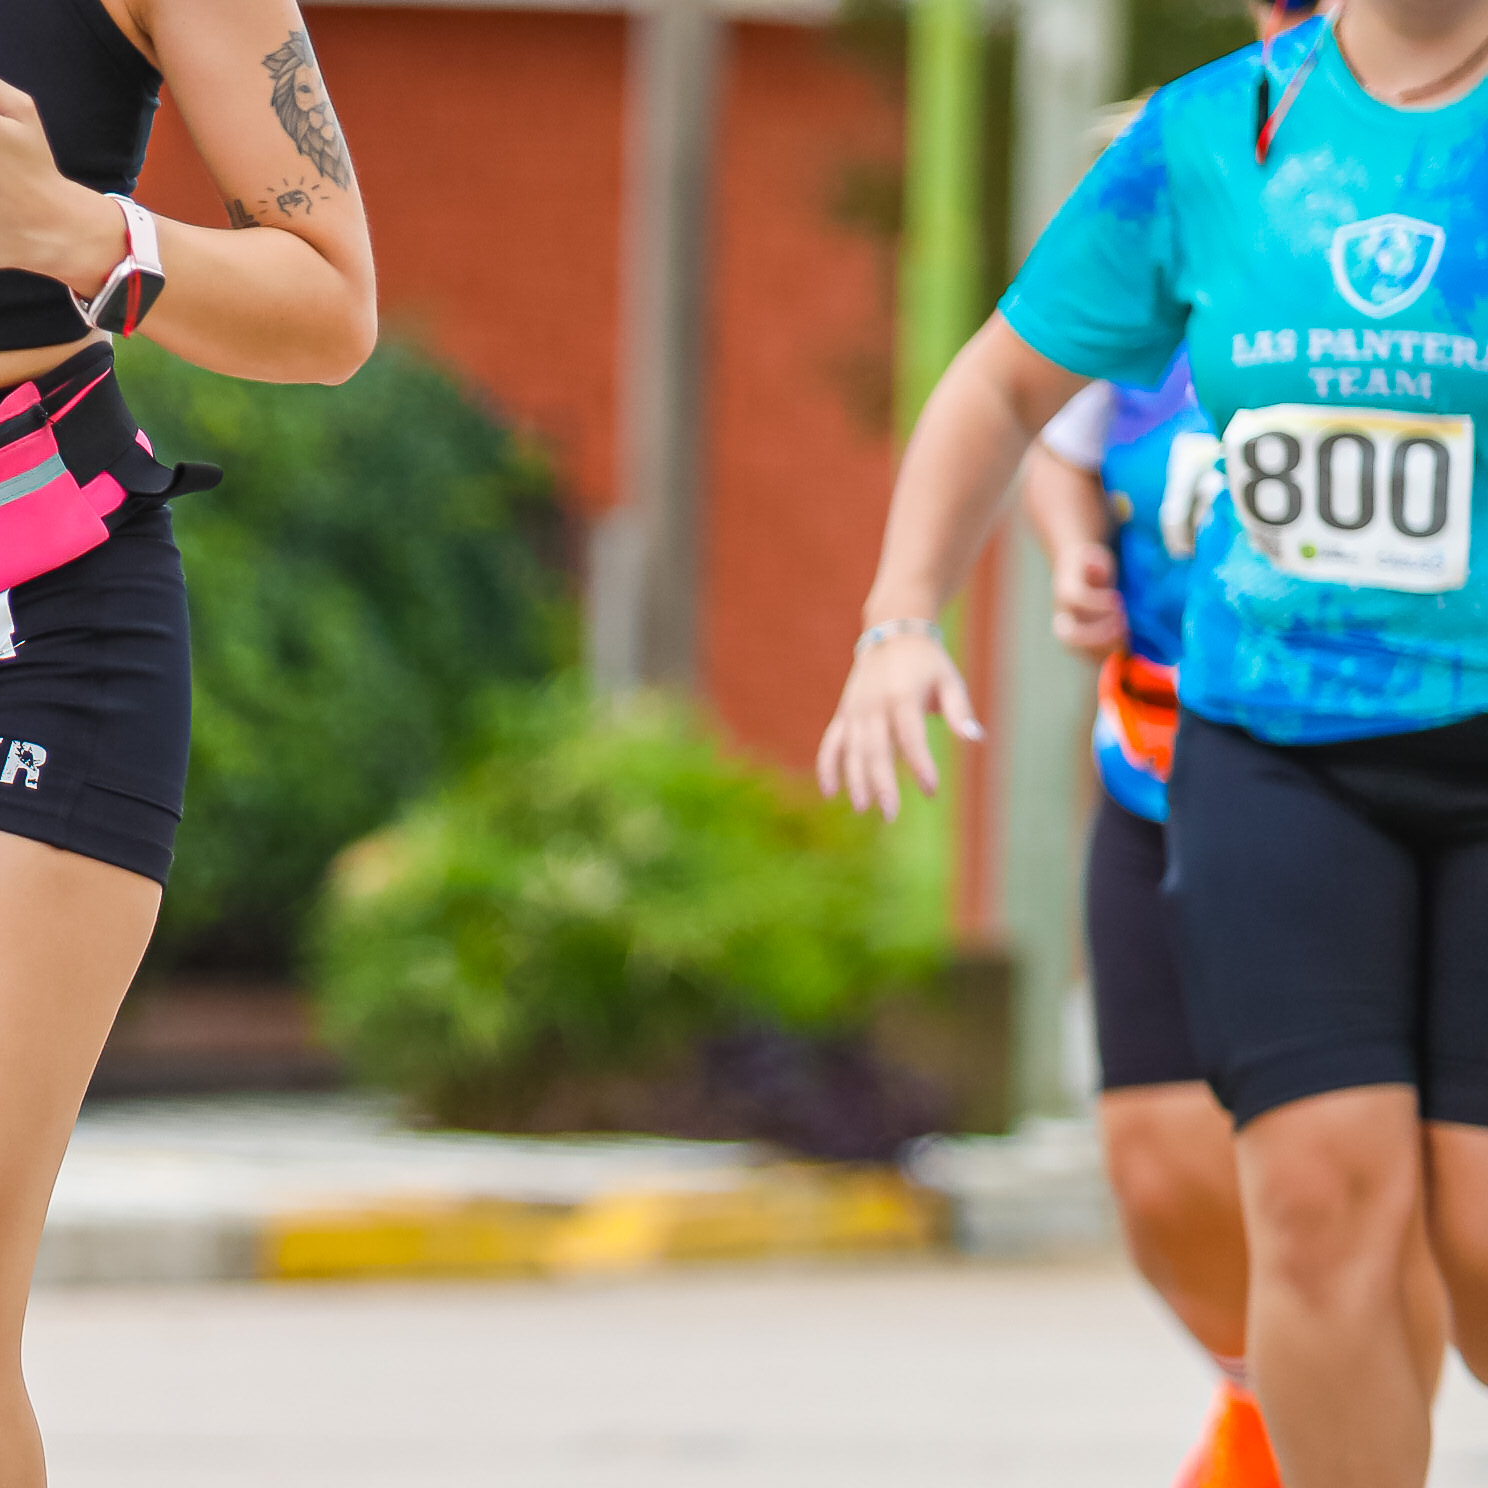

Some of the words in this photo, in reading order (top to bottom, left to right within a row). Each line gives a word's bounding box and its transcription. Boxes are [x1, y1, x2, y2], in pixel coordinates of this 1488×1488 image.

[1231, 328, 1298, 368] LAS
[1308, 366, 1433, 400] TEAM
[1244, 431, 1450, 538] 800
